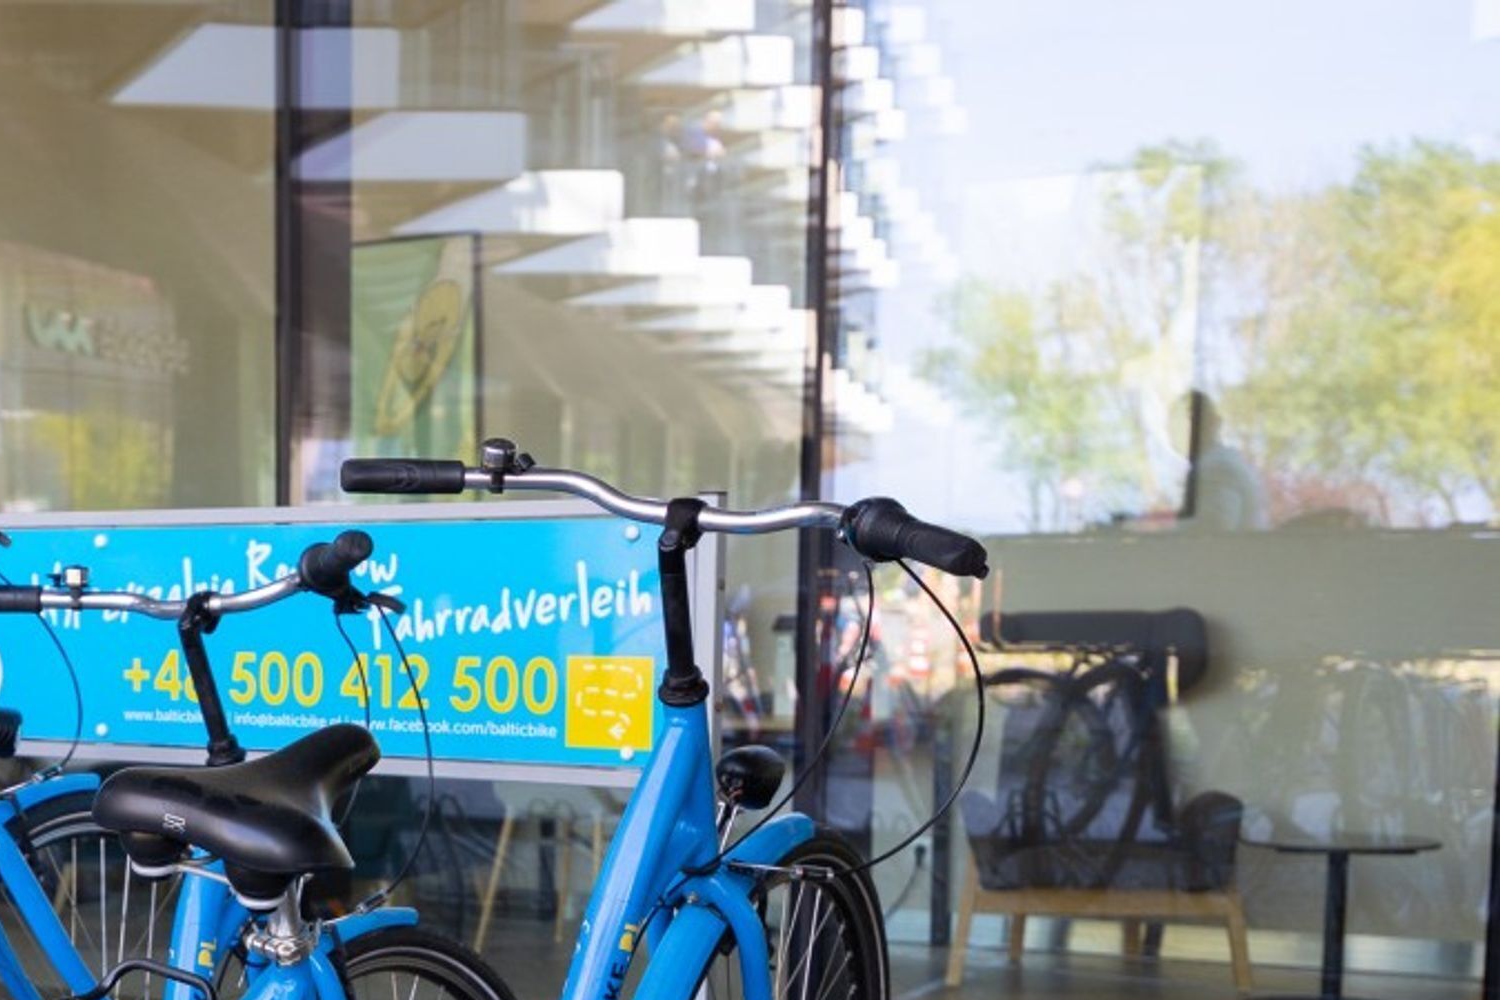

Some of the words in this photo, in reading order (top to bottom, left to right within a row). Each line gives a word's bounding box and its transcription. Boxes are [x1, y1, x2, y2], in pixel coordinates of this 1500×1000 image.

[367, 559, 652, 649] Fahrradverleih
[229, 651, 324, 707] 500
[339, 653, 429, 709] 412
[449, 655, 559, 715] 500
